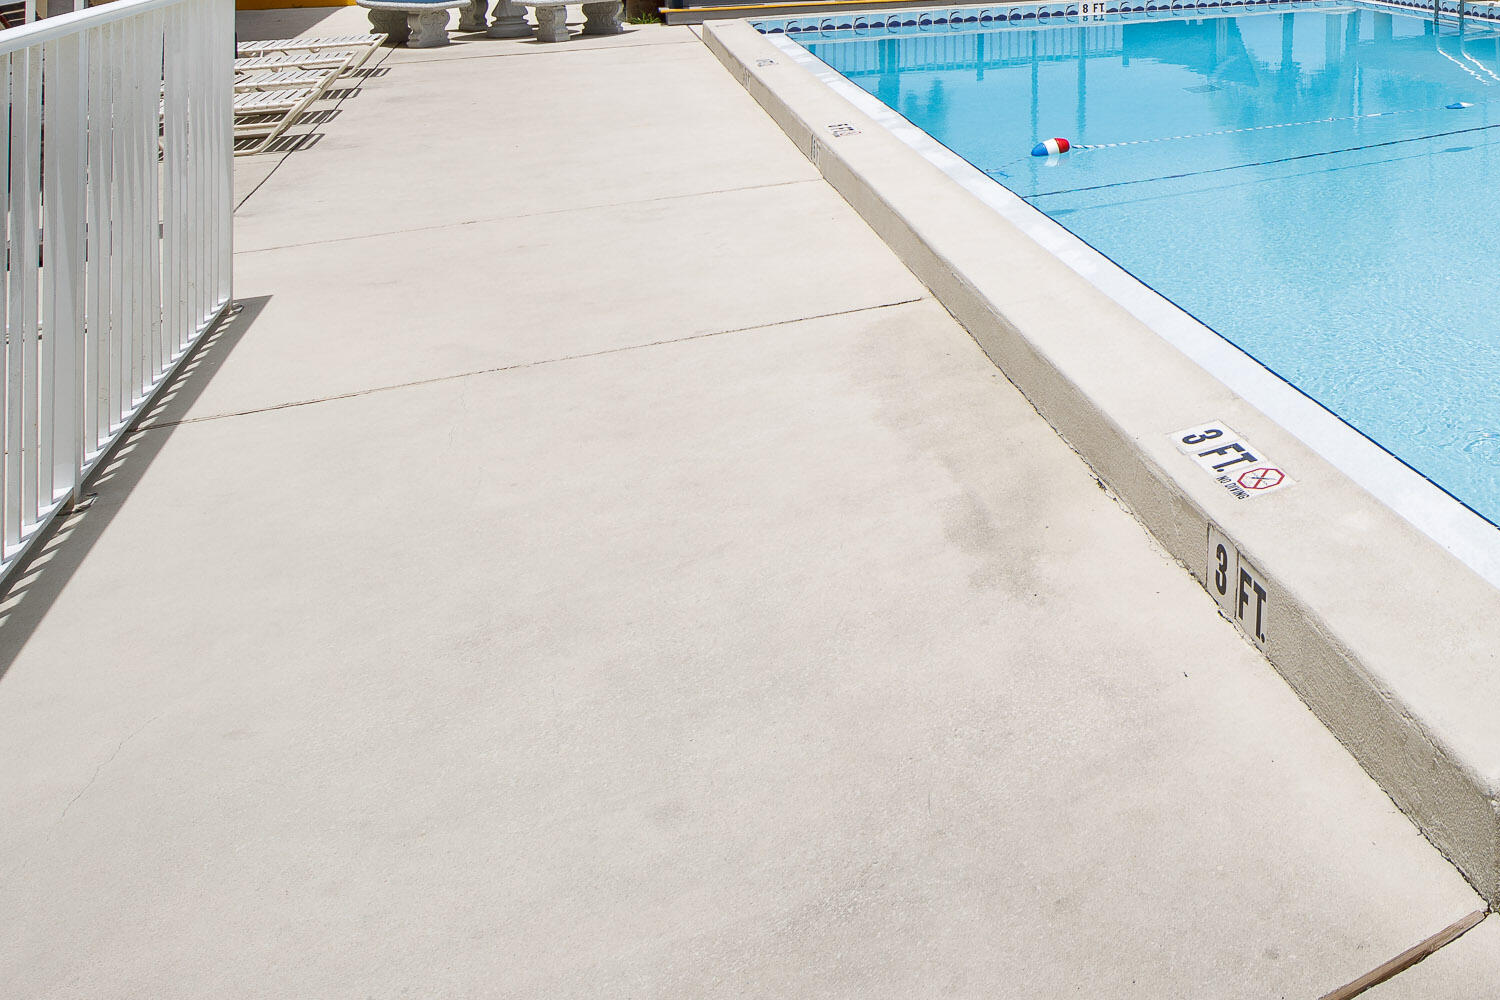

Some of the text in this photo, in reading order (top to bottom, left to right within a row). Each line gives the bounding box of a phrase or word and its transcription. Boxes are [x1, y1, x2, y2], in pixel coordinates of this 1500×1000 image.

[1082, 3, 1089, 14] 8
[1182, 428, 1259, 473] 3 FT.
[1216, 475, 1250, 500] NO DIVING
[1215, 543, 1268, 644] 3 FT.
